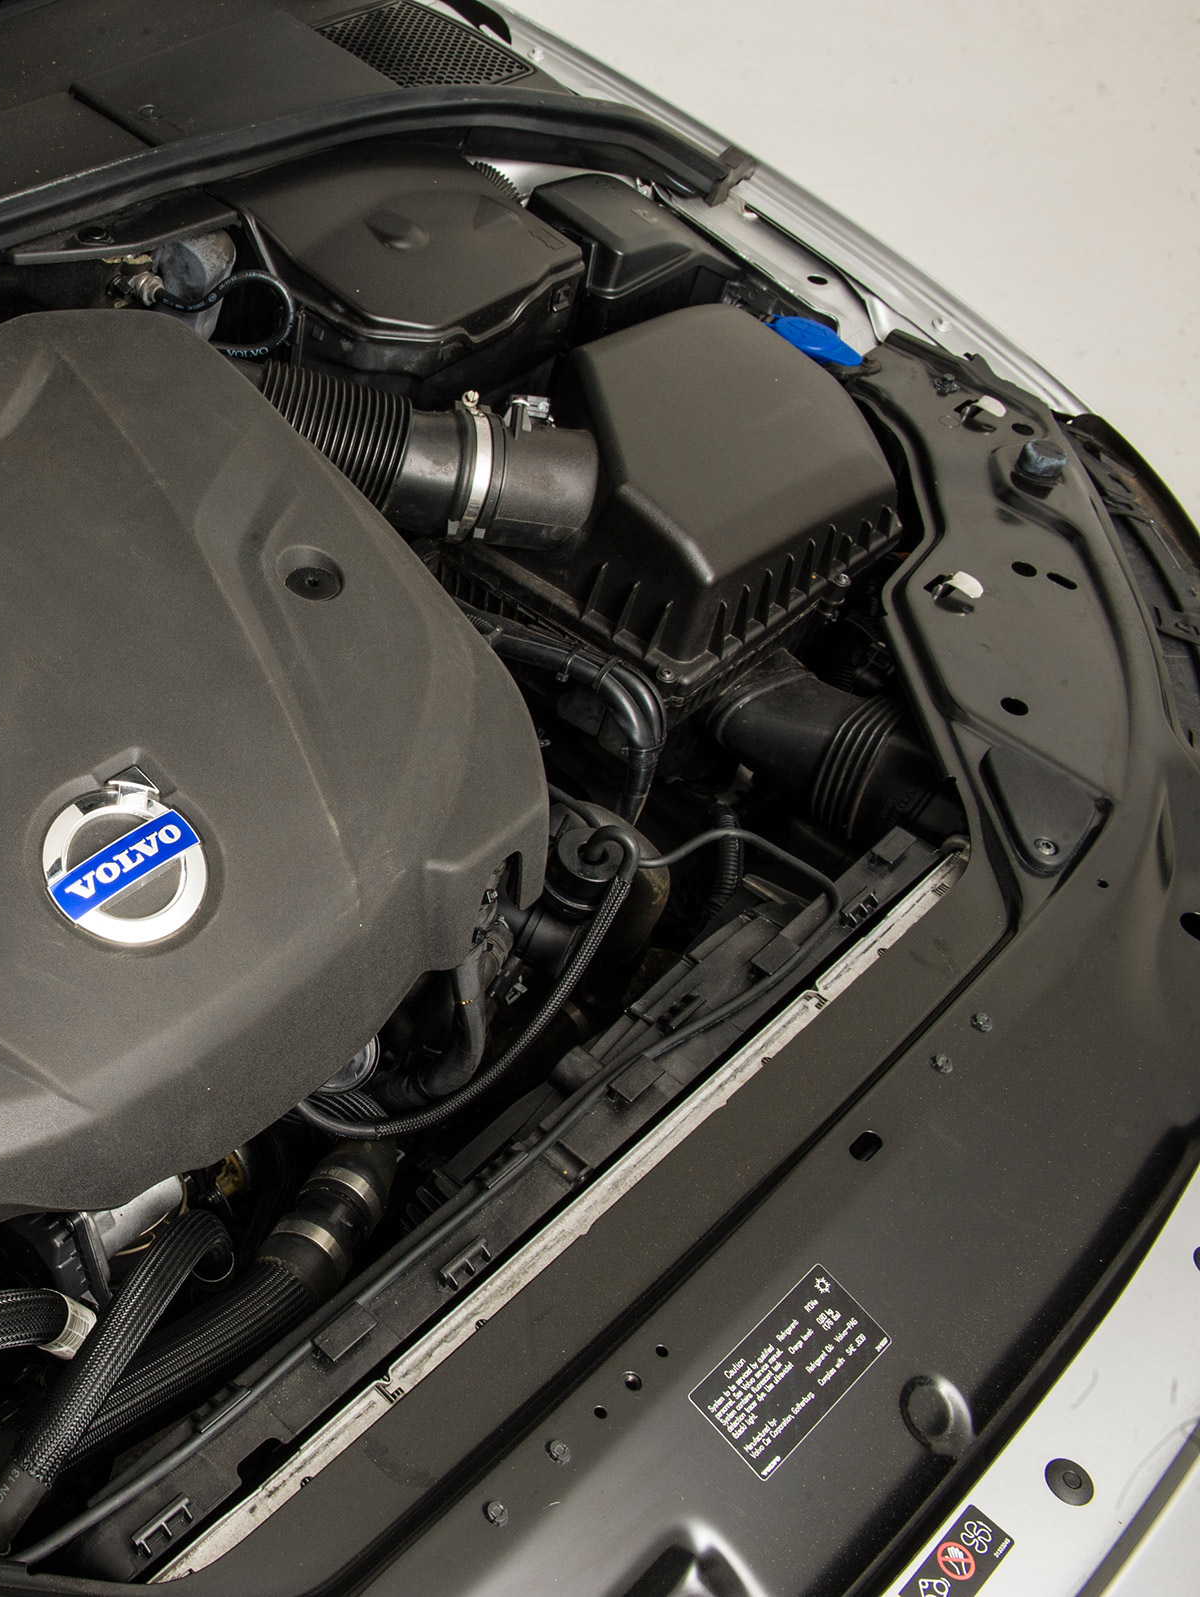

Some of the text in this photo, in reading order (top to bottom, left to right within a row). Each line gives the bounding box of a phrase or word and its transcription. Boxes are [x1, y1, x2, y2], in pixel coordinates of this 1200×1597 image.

[226, 346, 269, 358] VOLVO
[64, 824, 182, 899] VOLVO
[724, 1358, 746, 1379] Caution
[8, 1468, 20, 1482] 13
[761, 1456, 781, 1476] VOLVO
